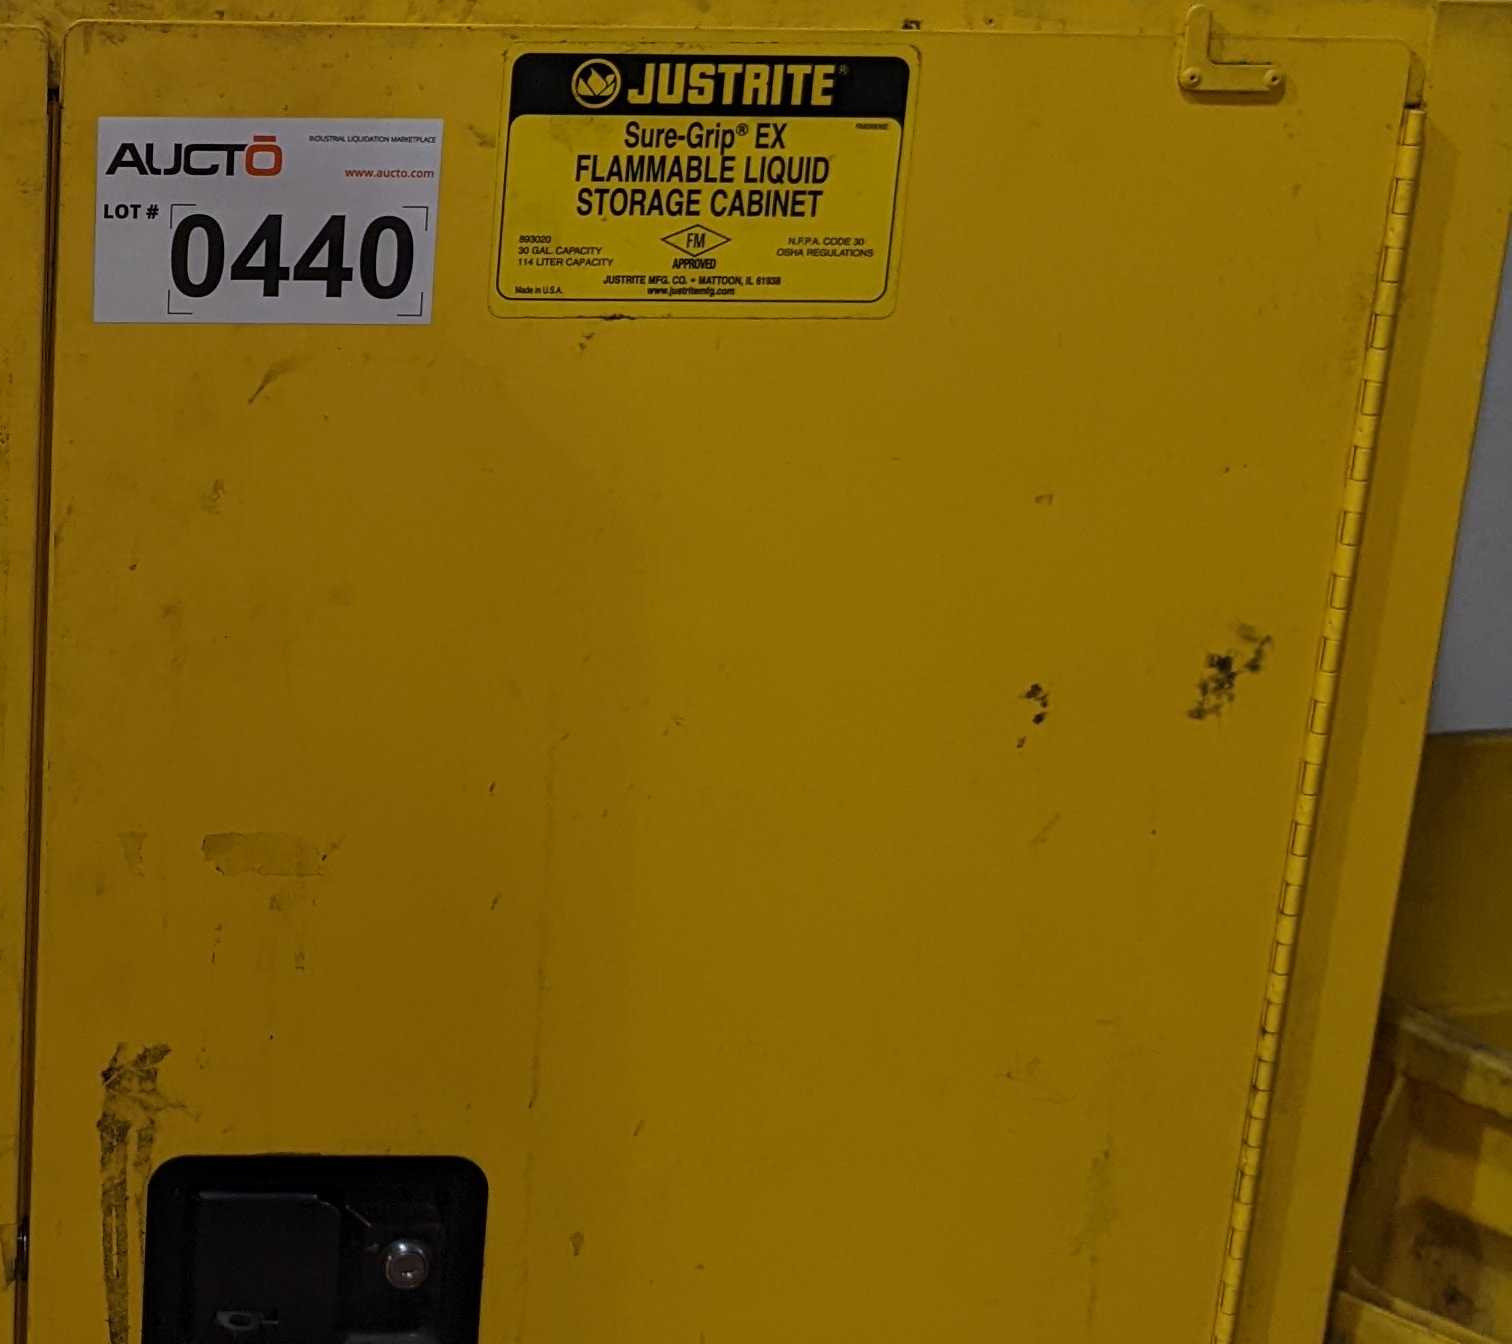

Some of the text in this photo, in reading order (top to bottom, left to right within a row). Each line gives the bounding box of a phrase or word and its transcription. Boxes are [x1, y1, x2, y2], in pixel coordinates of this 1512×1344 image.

[754, 122, 788, 150] EX
[343, 167, 435, 179] www.aucto.com
[574, 154, 830, 185] FLAMMABLE LIQUID
[576, 187, 825, 218] STORAGE CABINET
[103, 203, 160, 221] LOT #
[685, 232, 706, 249] FM
[822, 237, 851, 247] CODE
[169, 212, 415, 300] 0440
[555, 246, 603, 256] CAPACITY
[775, 248, 874, 258] OSHA REGULATIONS
[535, 258, 564, 267] LITER
[564, 258, 614, 268] CAPACITY
[671, 257, 717, 270] APPROVED
[602, 274, 647, 286] JUSTRITE
[514, 286, 533, 295] Made
